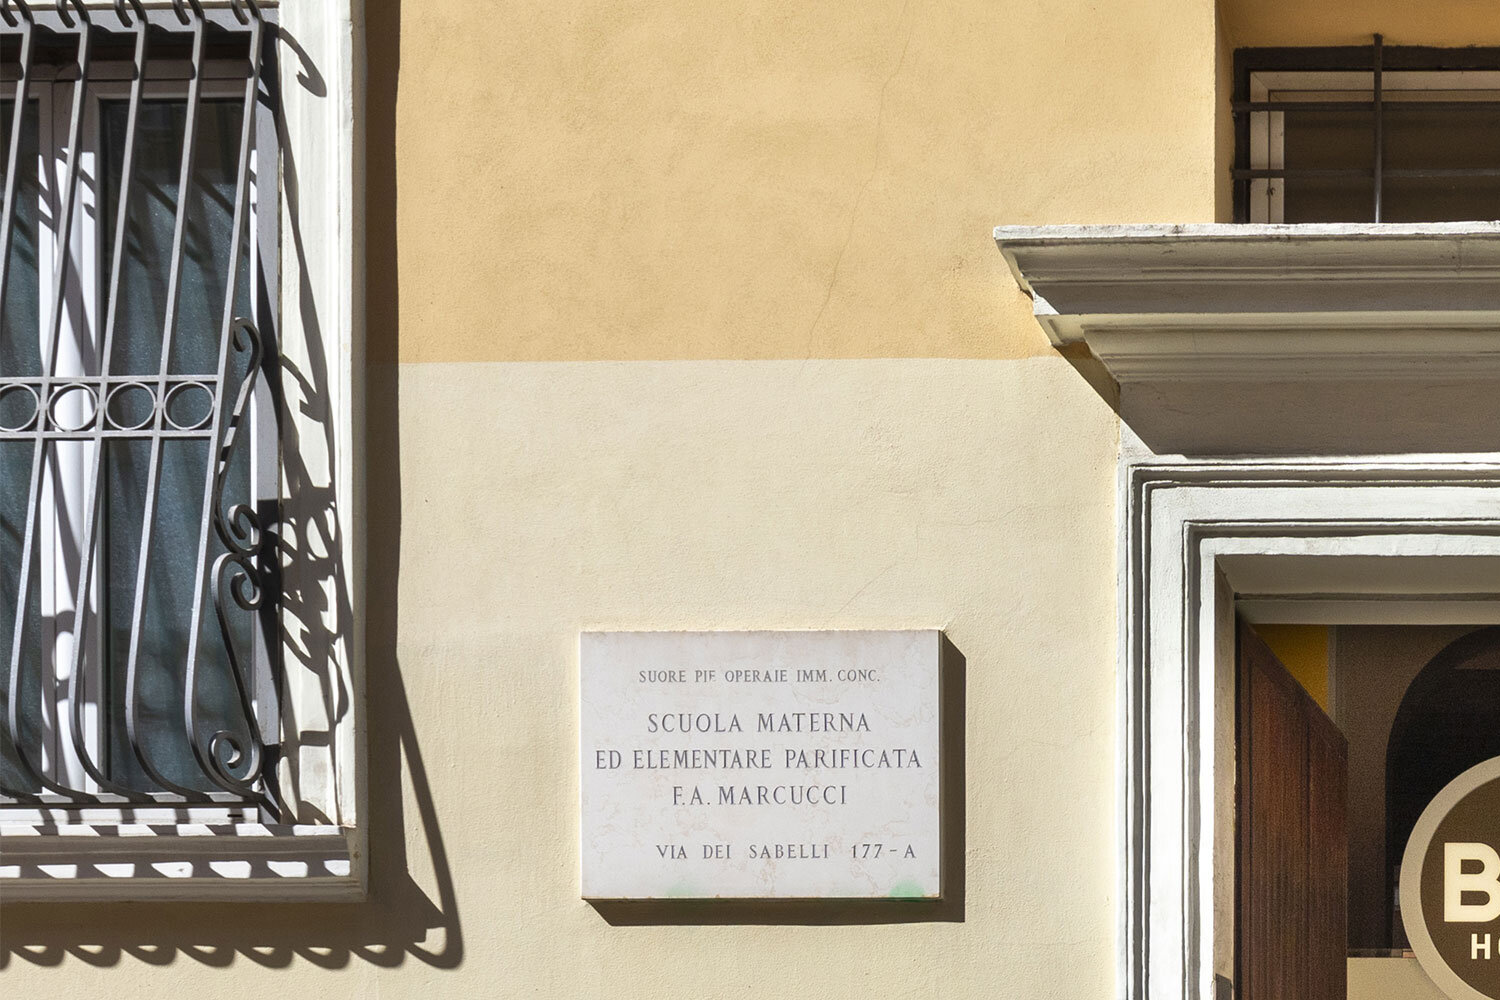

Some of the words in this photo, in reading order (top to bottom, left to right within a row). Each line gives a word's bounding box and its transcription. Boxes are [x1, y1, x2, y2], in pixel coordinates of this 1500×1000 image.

[639, 670, 687, 683] SUORE
[725, 670, 788, 683] OPERAIE
[796, 669, 833, 683] IMM.
[837, 669, 881, 683] CONC.
[647, 713, 743, 734] SCUOLA
[757, 712, 871, 733] MATERNA
[595, 750, 622, 770] ED
[632, 749, 772, 769] ELEMENTARE
[784, 748, 922, 769] PARIFICATA
[718, 785, 848, 806] MARCUCCI
[656, 844, 688, 860] VIA
[702, 844, 732, 860] DEI
[749, 844, 829, 860] SABELLI
